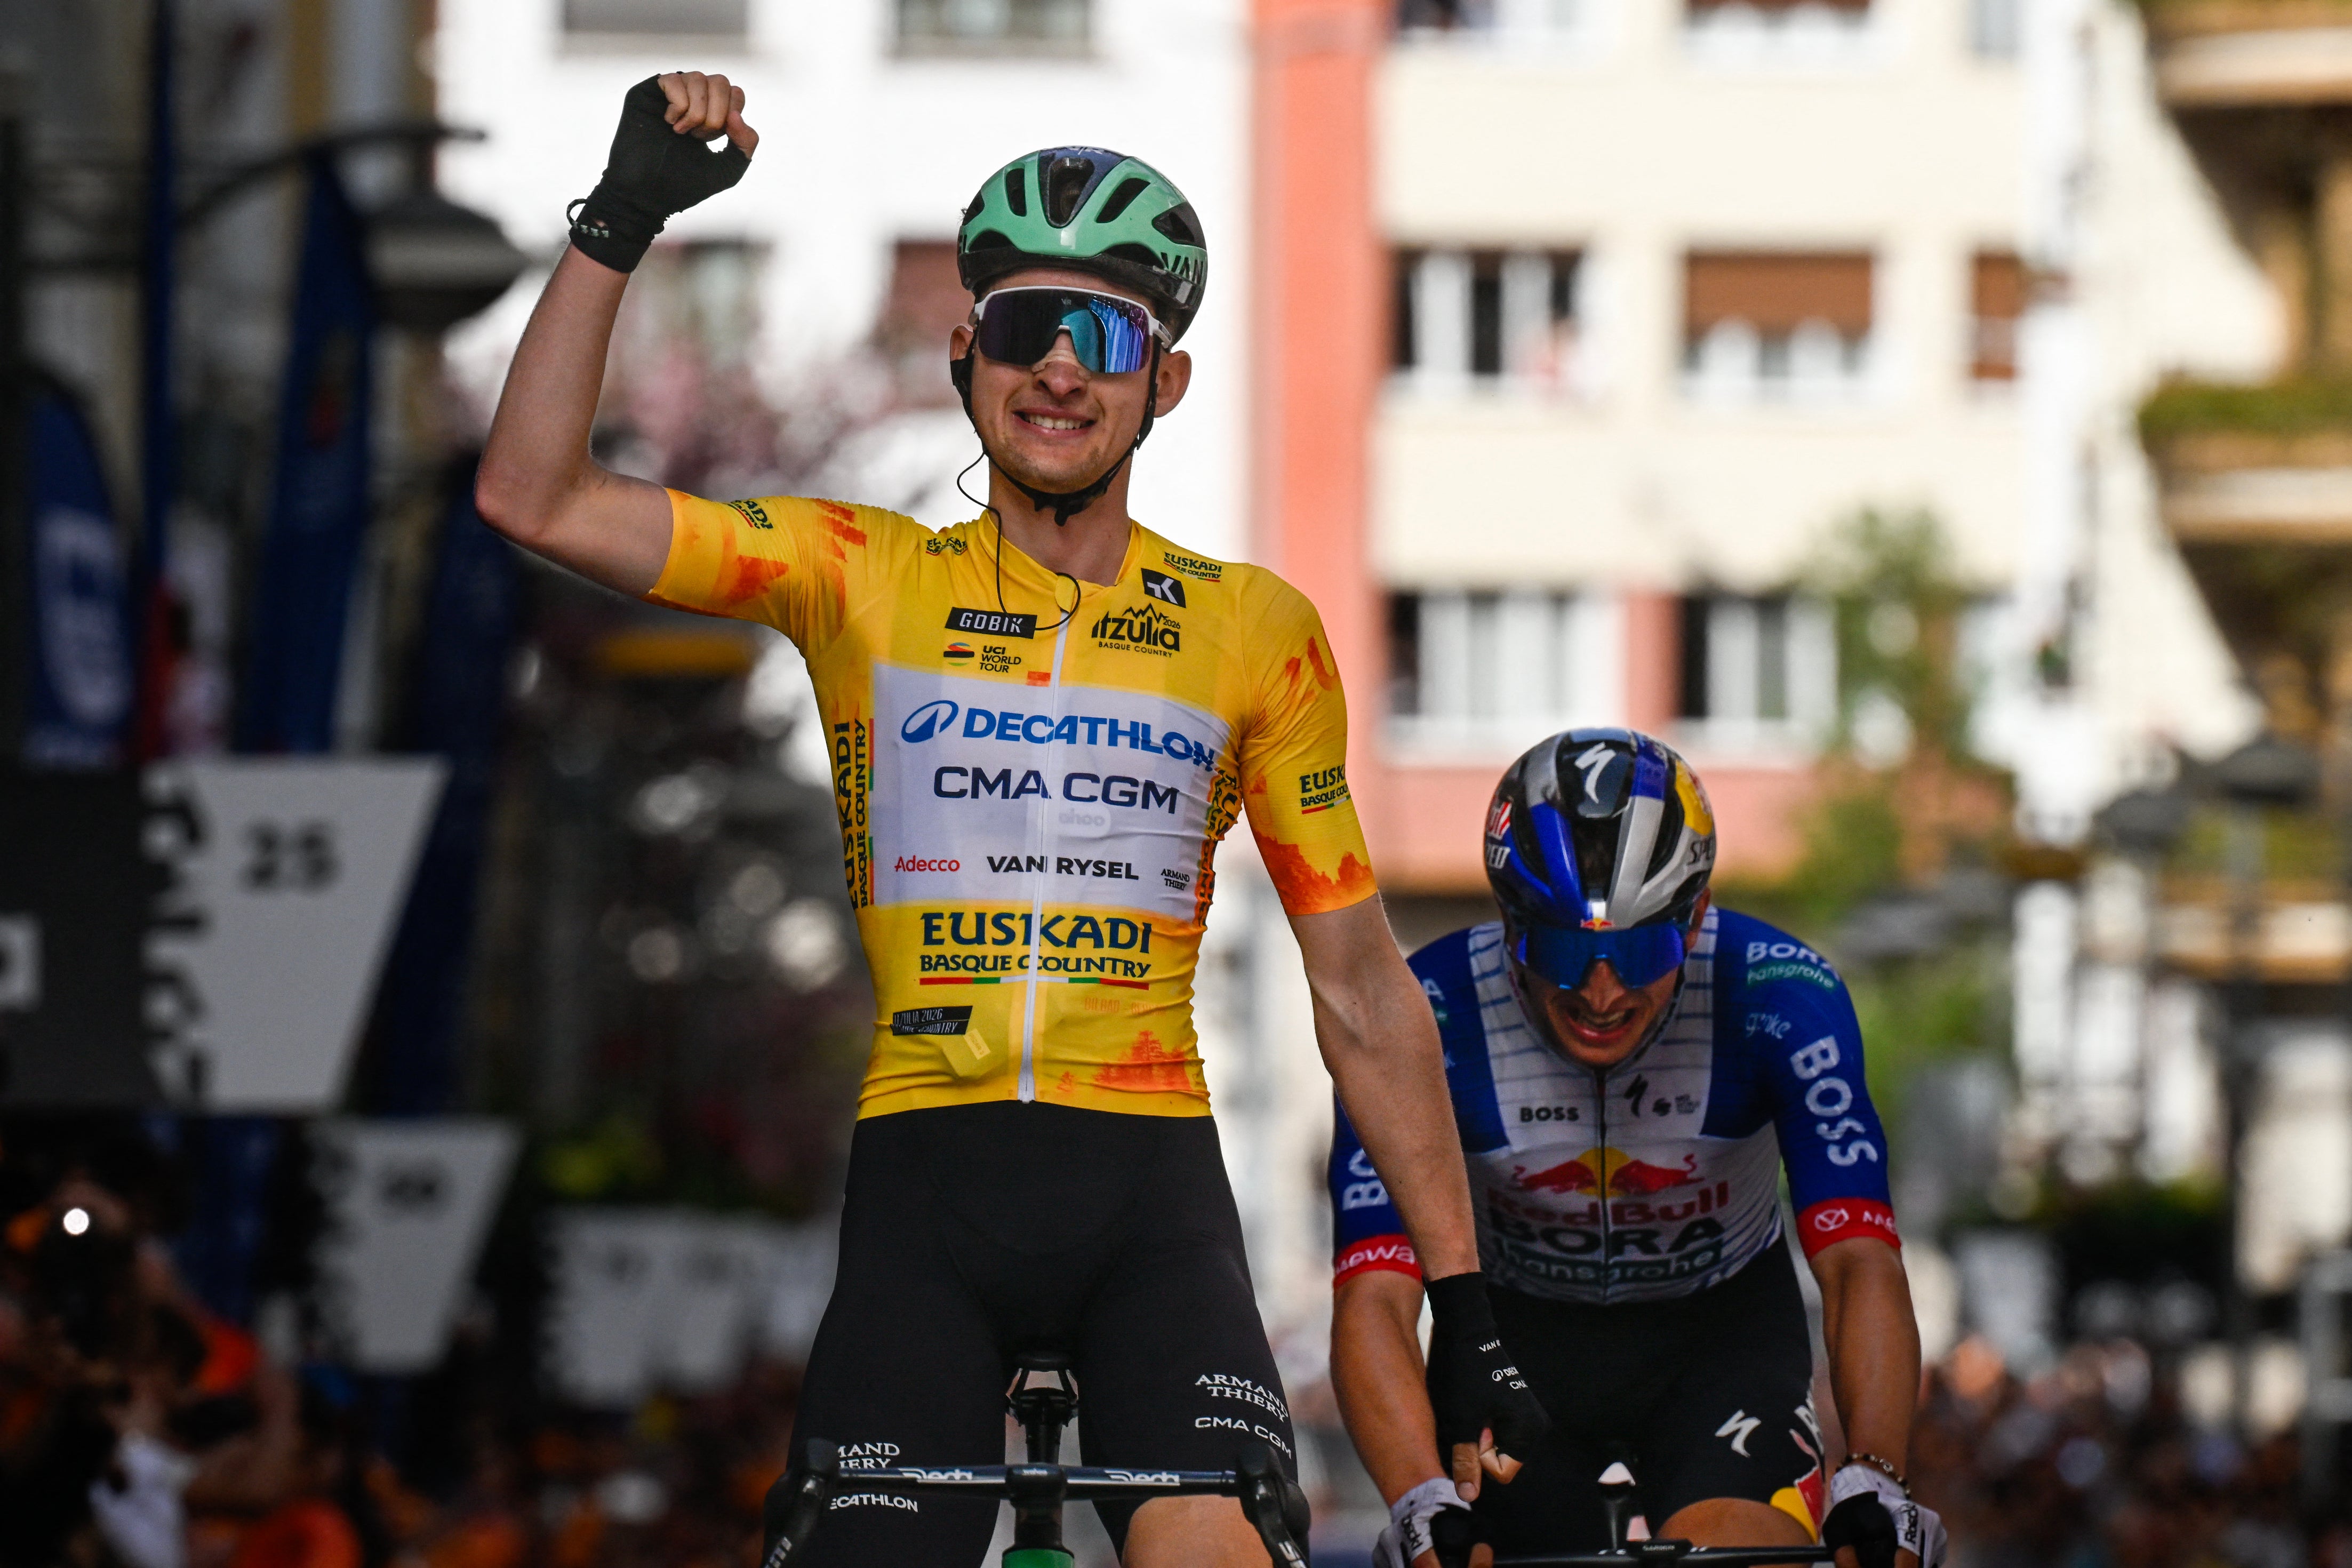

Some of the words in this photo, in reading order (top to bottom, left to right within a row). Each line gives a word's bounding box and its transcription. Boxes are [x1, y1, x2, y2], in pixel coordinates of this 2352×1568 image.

[1164, 551, 1222, 573] EUSKADI
[1187, 570, 1221, 579] COUNTRY
[959, 612, 1023, 633] GOBIK
[1163, 618, 1181, 629] 2026
[983, 645, 1006, 655] UCI
[1098, 641, 1131, 651] BASQUE
[1134, 646, 1172, 658] COUNTRY
[979, 662, 1009, 673] TOUR
[981, 654, 1021, 665] WORLD
[962, 707, 1214, 772] DECATHLON
[854, 718, 866, 827] COUNTRY
[934, 766, 1052, 799] CMA
[1062, 772, 1180, 814] CGM
[1300, 790, 1336, 807] BASQUE
[855, 830, 869, 908] BASQUE
[894, 855, 960, 873] Adecco
[987, 855, 1047, 873] VAN
[1056, 857, 1139, 880] RYSEL
[1161, 868, 1190, 882] ARMAND
[1164, 878, 1187, 891] THIERY
[921, 912, 1153, 954] EUSKADI
[919, 954, 1012, 973] BASQUE
[1018, 954, 1152, 978] COUNTRY
[922, 1008, 943, 1022] 2026
[1790, 1035, 1878, 1167] BOSS
[1519, 1107, 1580, 1122] BOSS
[1478, 1340, 1496, 1352] VAN
[1195, 1374, 1289, 1418] ARMAND
[1206, 1386, 1285, 1423] THIERY
[1195, 1417, 1250, 1432] CMA
[1254, 1425, 1292, 1460] CGM
